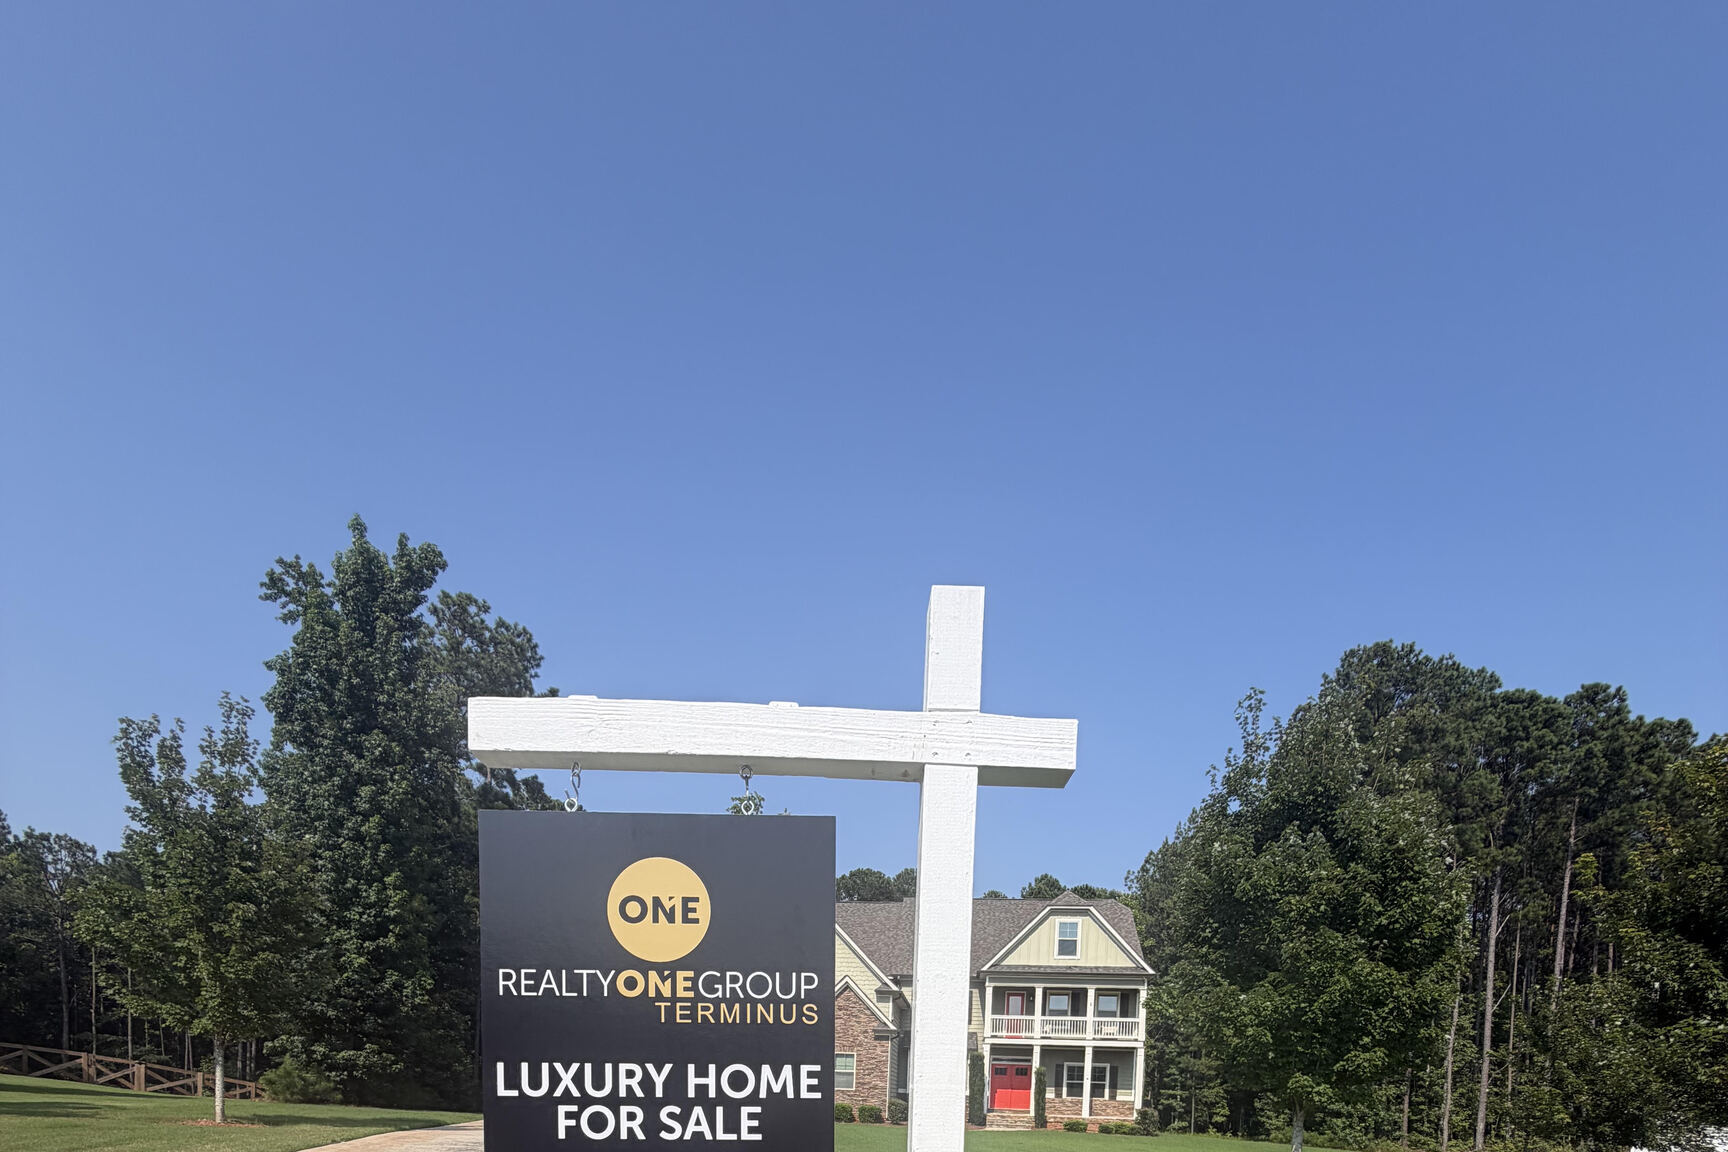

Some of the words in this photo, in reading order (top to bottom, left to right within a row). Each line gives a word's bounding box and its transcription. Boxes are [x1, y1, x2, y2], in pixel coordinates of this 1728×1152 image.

[618, 894, 700, 925] ONE
[654, 1002, 819, 1025] TERMINUS
[496, 1061, 674, 1098] LUXURY
[687, 1063, 822, 1099] HOME
[557, 1104, 647, 1140] FOR
[659, 1105, 763, 1141] SALE
